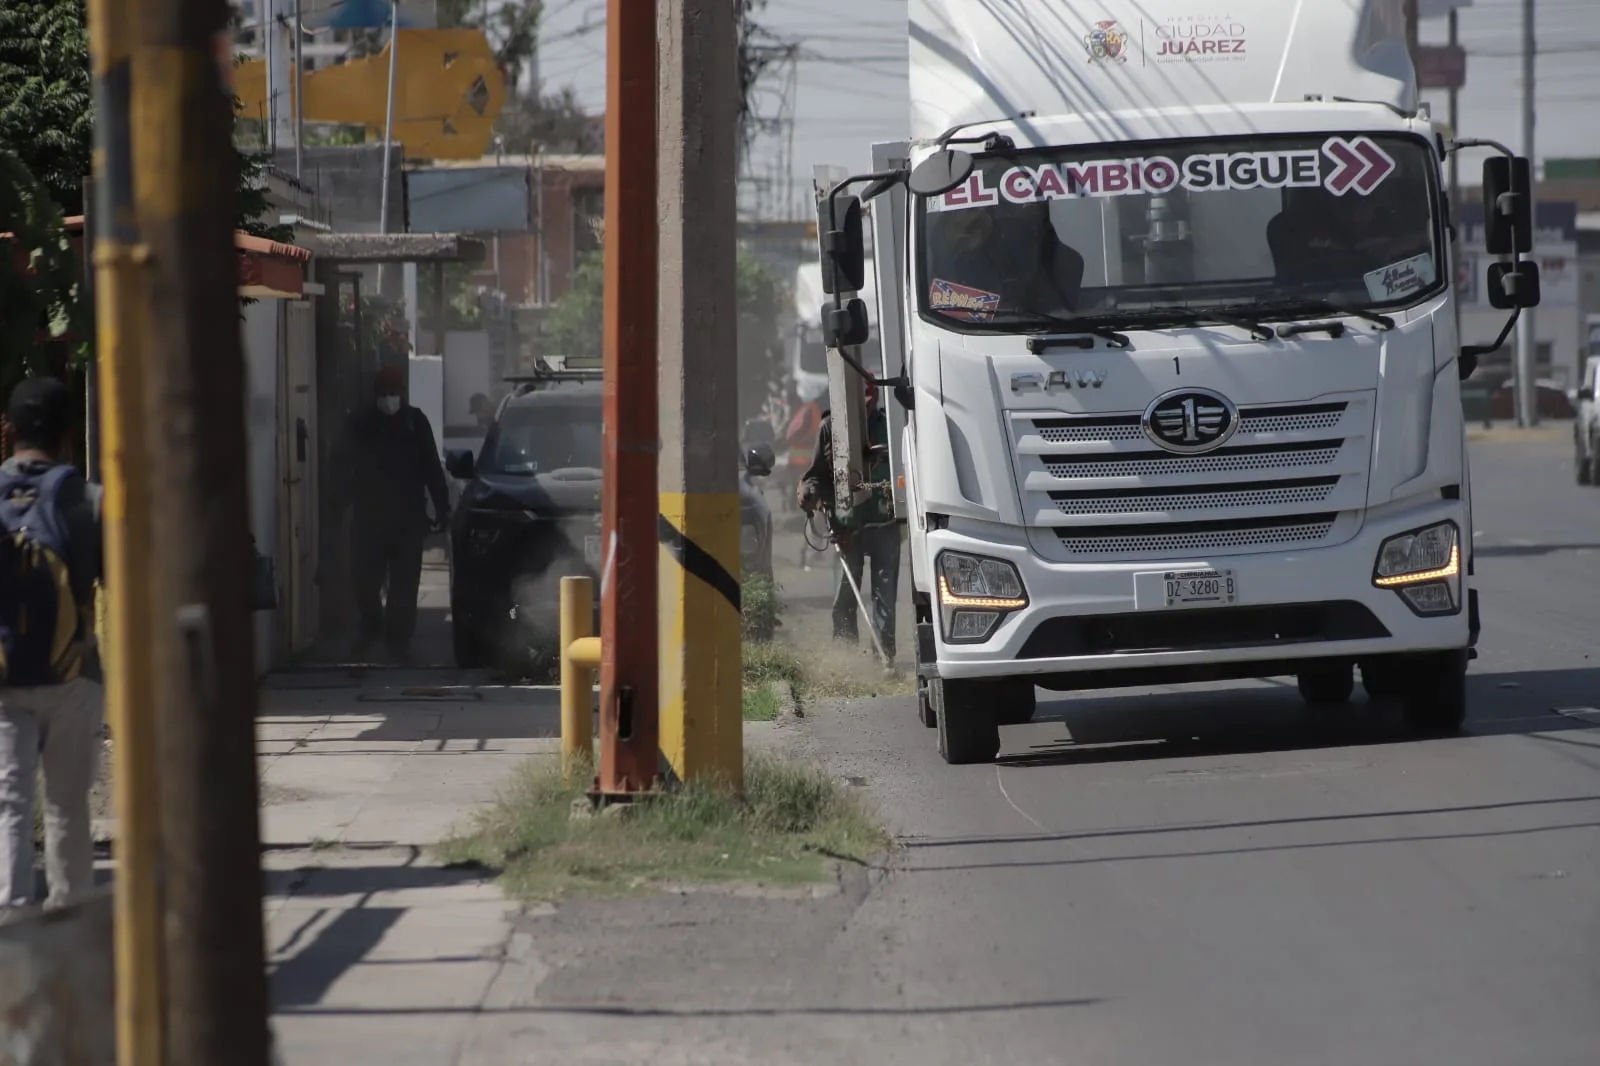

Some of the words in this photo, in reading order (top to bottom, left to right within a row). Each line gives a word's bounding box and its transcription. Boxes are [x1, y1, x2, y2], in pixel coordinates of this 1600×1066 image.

[1155, 23, 1246, 39] CIUDAD
[1156, 37, 1247, 56] JUÁREZ
[944, 175, 994, 206] EL
[1004, 160, 1178, 200] CAMBIO
[1187, 154, 1318, 188] SIGUE
[1172, 355, 1182, 376] 1
[1010, 370, 1108, 392] FAW
